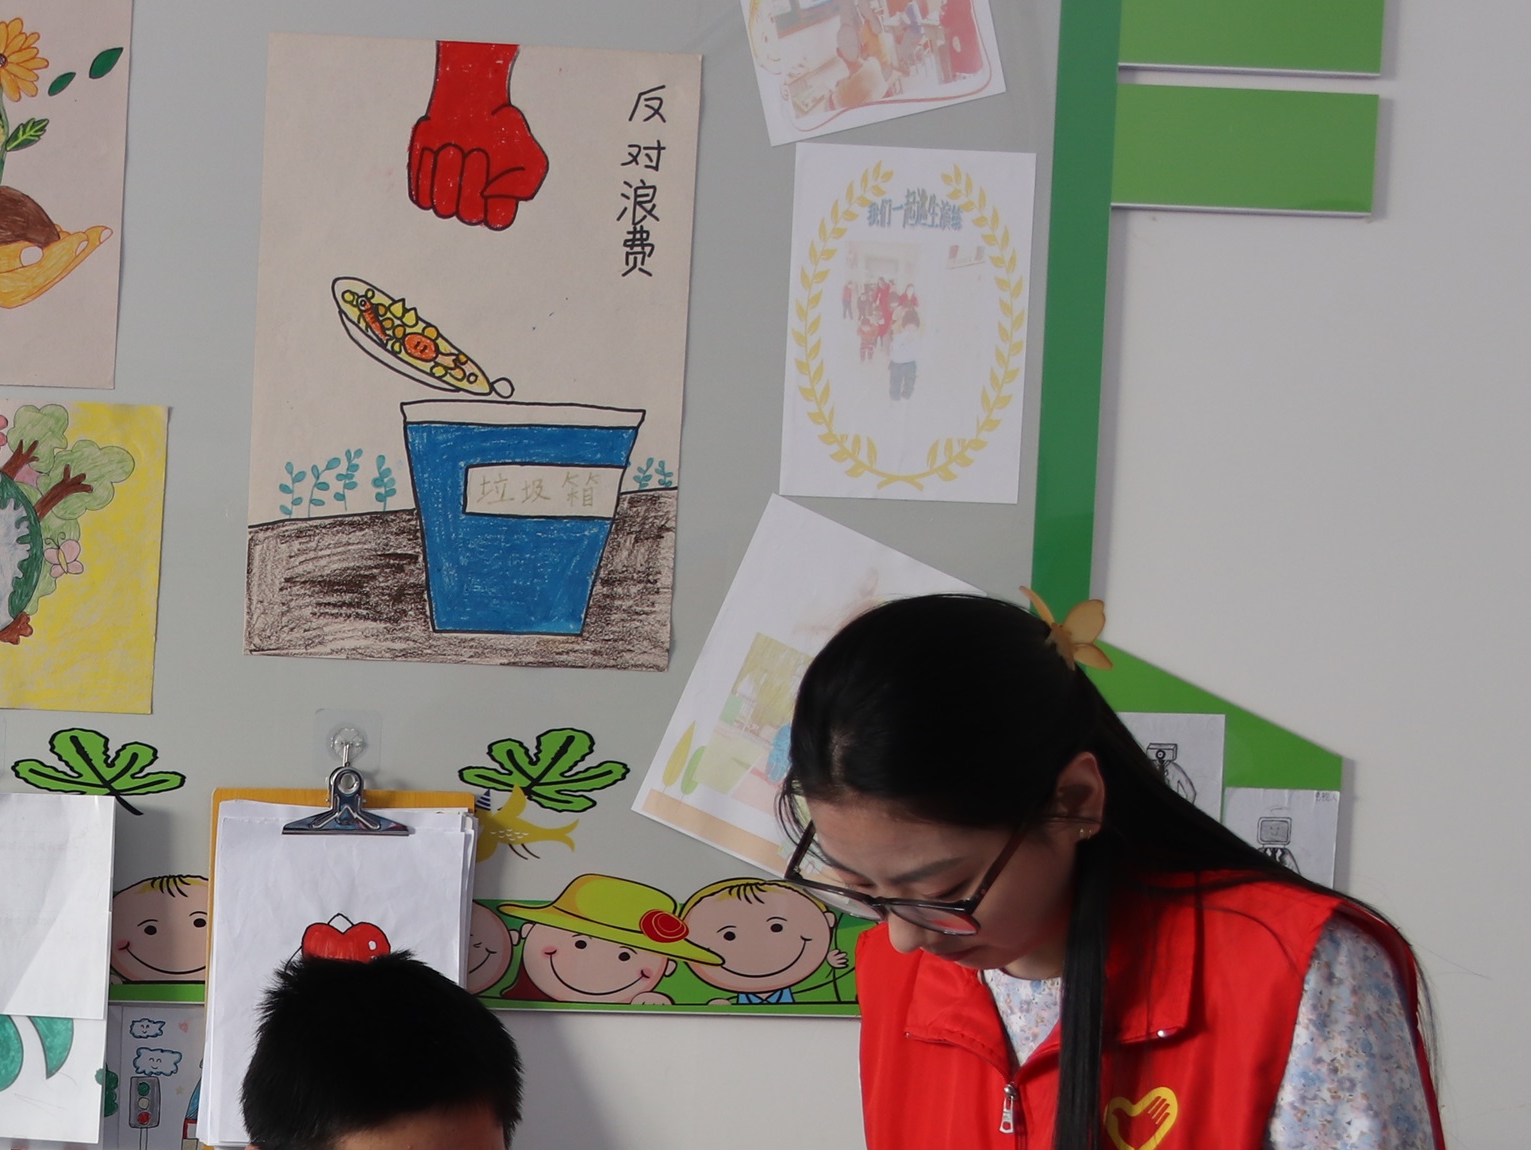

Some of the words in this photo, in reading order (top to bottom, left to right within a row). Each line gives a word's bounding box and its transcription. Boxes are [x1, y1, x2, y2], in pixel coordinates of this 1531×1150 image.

[616, 85, 668, 277] 反对浪费
[477, 473, 602, 508] 垃圾箱
